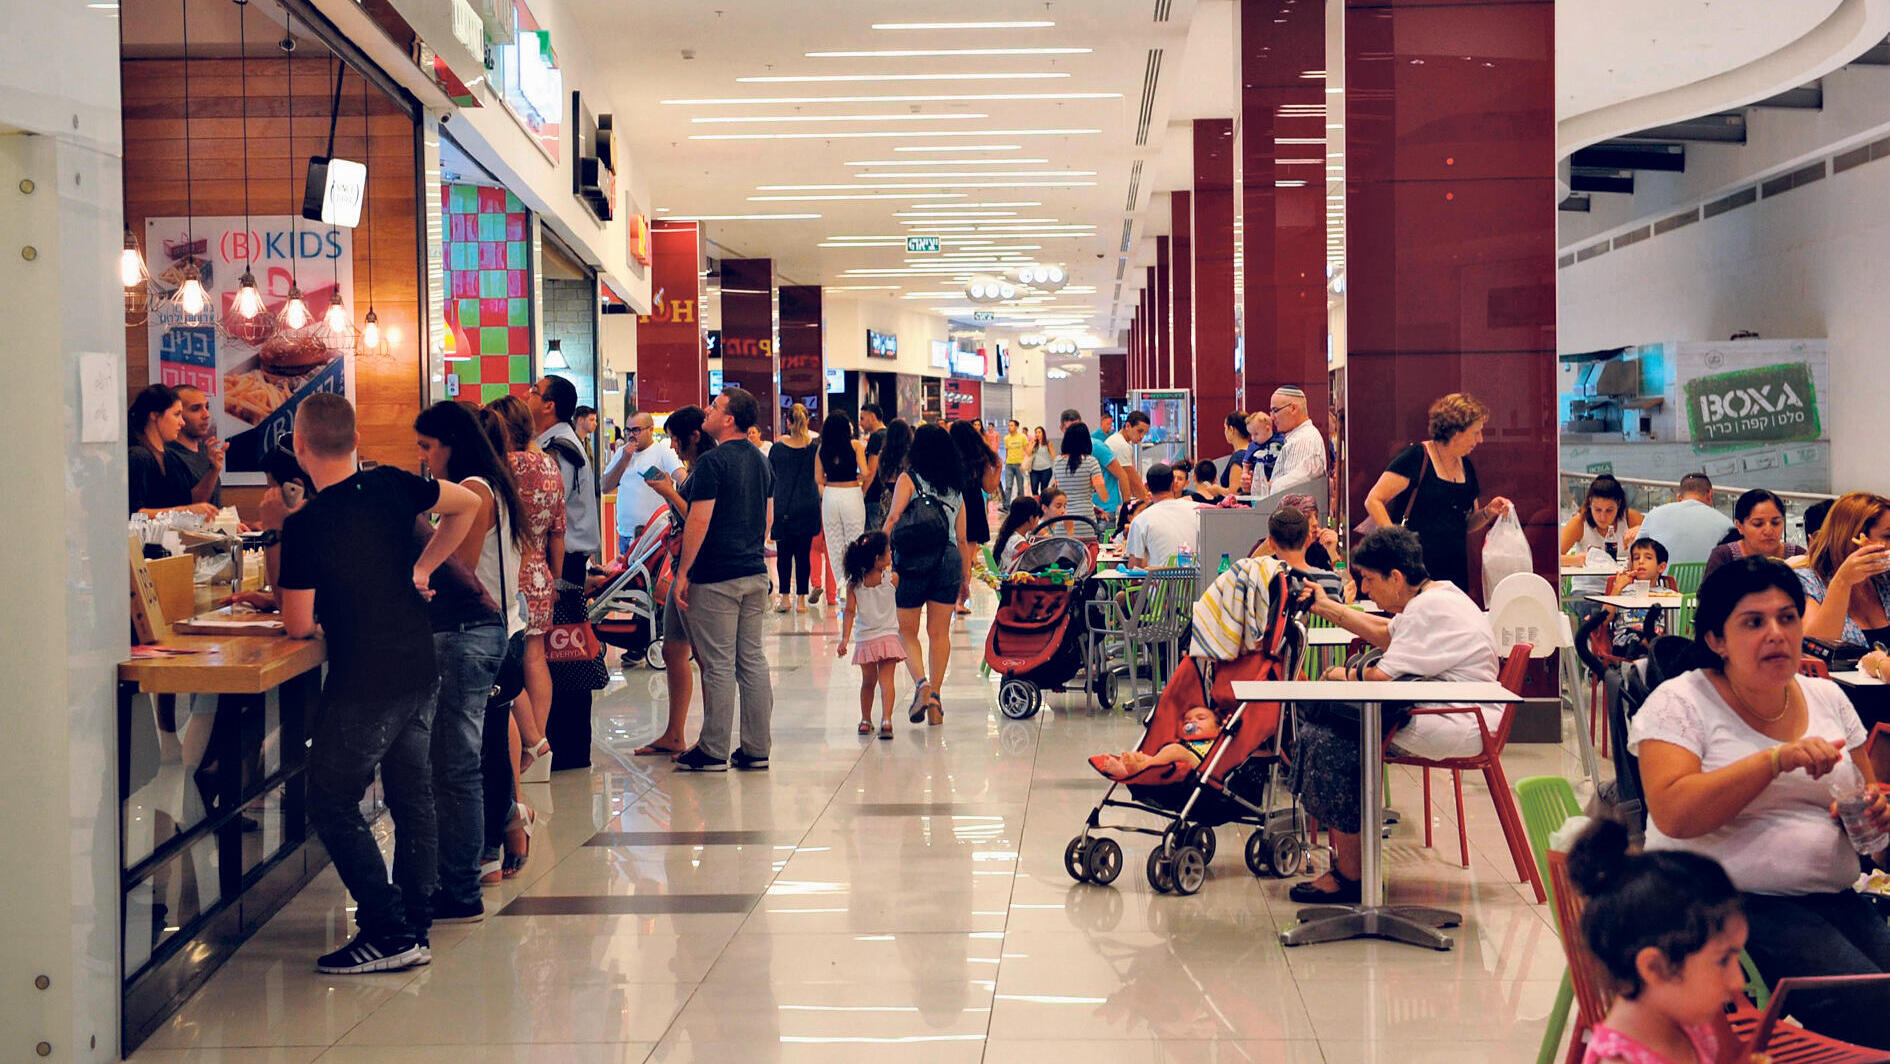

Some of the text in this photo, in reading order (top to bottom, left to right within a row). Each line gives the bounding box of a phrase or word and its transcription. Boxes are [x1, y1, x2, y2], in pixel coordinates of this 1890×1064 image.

[1699, 381, 1804, 423] BOXA
[1705, 410, 1805, 438] סלט קפה כריך
